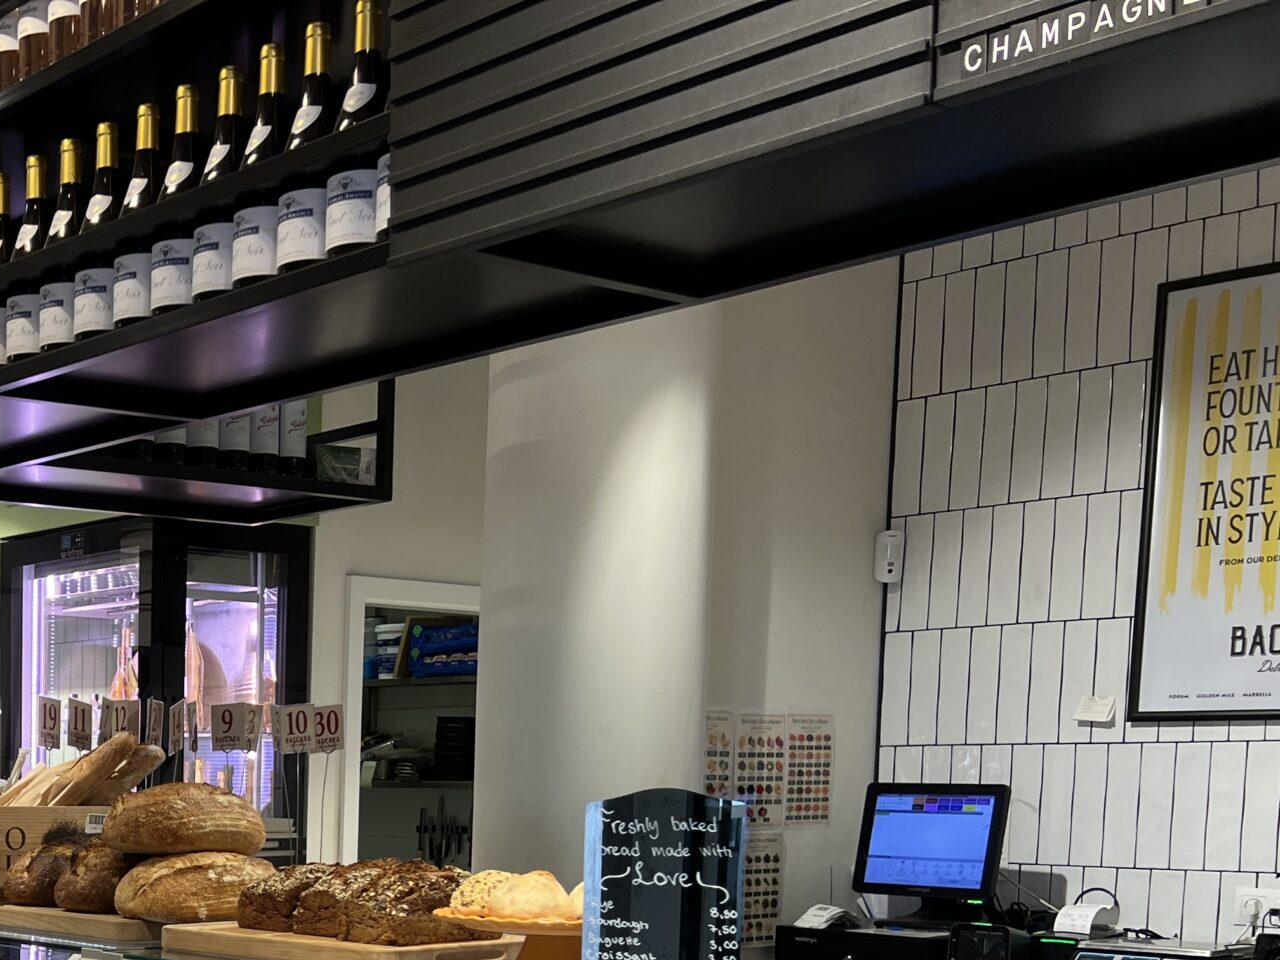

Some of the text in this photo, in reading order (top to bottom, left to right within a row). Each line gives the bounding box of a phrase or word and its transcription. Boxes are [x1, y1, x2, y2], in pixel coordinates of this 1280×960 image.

[963, 0, 1200, 72] CHAMPAGN
[1207, 349, 1256, 385] EAT
[1203, 424, 1237, 457] OR
[1200, 474, 1276, 511] TASTE
[1196, 516, 1221, 548] IN
[1219, 557, 1244, 566] FROM
[1246, 556, 1264, 564] OUR
[42, 702, 57, 731] 19
[73, 705, 86, 732] 11
[114, 706, 127, 732] 12
[172, 705, 181, 736] 14
[221, 709, 234, 734] 9
[286, 710, 308, 736] 10
[314, 710, 339, 737] 30
[317, 736, 340, 745] ACCARA
[670, 816, 718, 834] baked
[651, 842, 690, 857] made
[699, 843, 733, 858] with
[631, 861, 694, 888] Love
